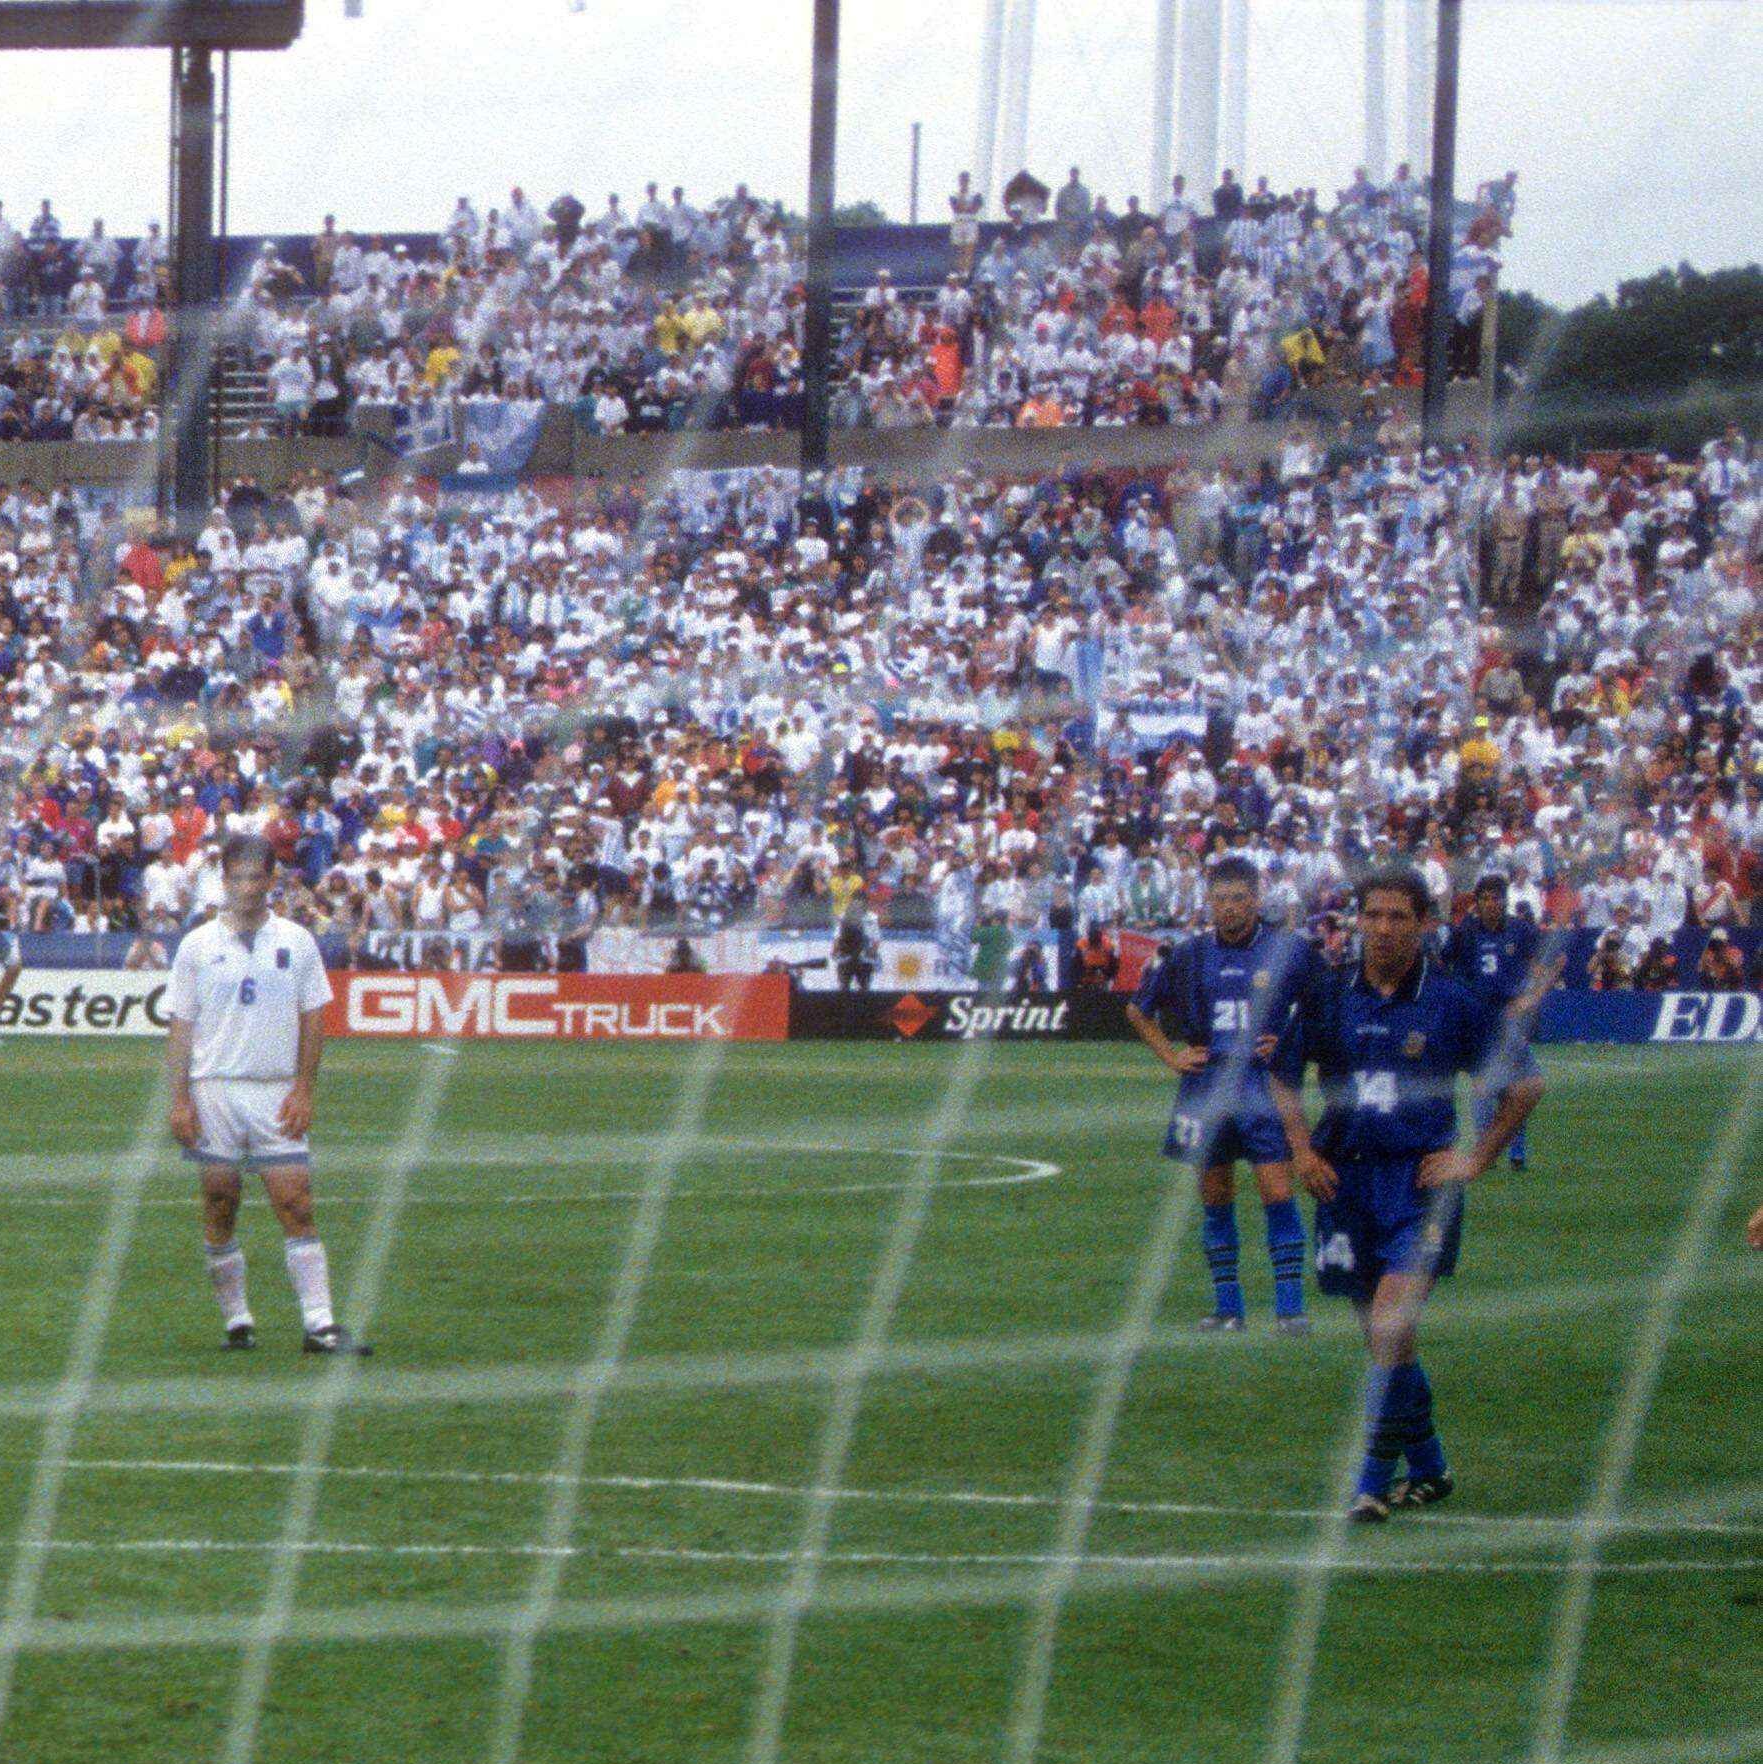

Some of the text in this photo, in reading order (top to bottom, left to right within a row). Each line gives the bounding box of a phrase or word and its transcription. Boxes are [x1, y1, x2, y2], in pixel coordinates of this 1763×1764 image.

[347, 976, 731, 1035] GMC TRUCK
[945, 996, 1070, 1039] Sprint
[1213, 1000, 1250, 1031] 21
[1650, 991, 1763, 1041] ED
